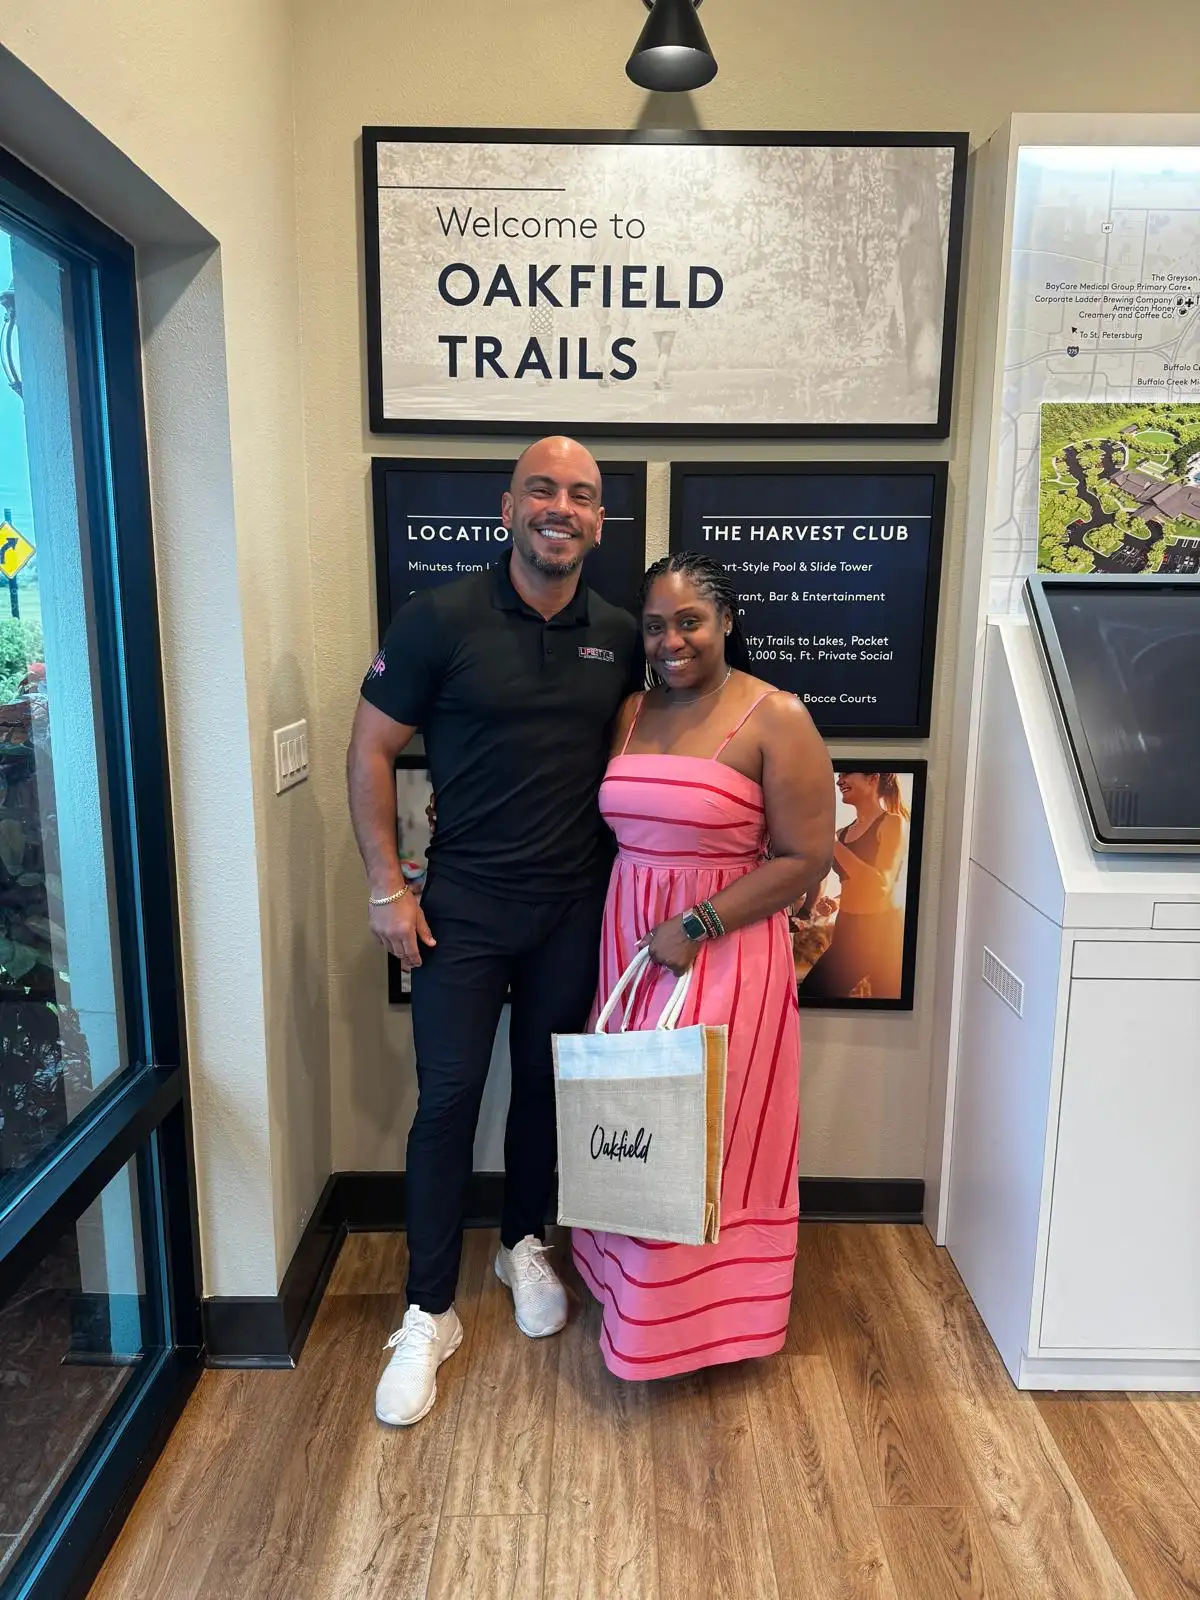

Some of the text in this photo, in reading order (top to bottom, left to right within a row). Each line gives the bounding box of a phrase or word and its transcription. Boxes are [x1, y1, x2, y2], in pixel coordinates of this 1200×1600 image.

[436, 206, 646, 239] Welcome to
[1151, 273, 1198, 283] The Greyson
[437, 262, 725, 309] OAKFIELD
[1045, 282, 1187, 293] BayCare Medical Group Primary Care
[1034, 295, 1173, 305] Corporate Ladder Brewing Company
[1112, 304, 1176, 313] American Honey
[1078, 311, 1175, 321] Creamery and Coffee Co.
[1080, 331, 1143, 341] To St. Petersburg
[438, 335, 638, 381] TRAILS
[1163, 363, 1191, 371] Buffalo
[1137, 377, 1165, 386] Buffalo
[1166, 378, 1188, 386] Creek
[407, 525, 509, 542] LOCATIO
[702, 525, 909, 541] THE HARVEST CLUB
[408, 560, 453, 572] Minutes
[456, 561, 483, 572] from
[722, 561, 873, 574] ort-Style Pool & Slide Tower
[738, 591, 886, 603] rant, Bar & Entertainment
[766, 635, 795, 646] Trails
[798, 637, 810, 646] to
[812, 636, 847, 647] Lakes,
[851, 635, 889, 646] Pocket
[779, 651, 797, 662] Sq.
[800, 651, 815, 661] Ft.
[818, 651, 857, 661] Private
[860, 650, 893, 661] Social
[803, 693, 837, 703] Bocce
[839, 693, 877, 703] Courts
[591, 1124, 652, 1163] Oakfield
